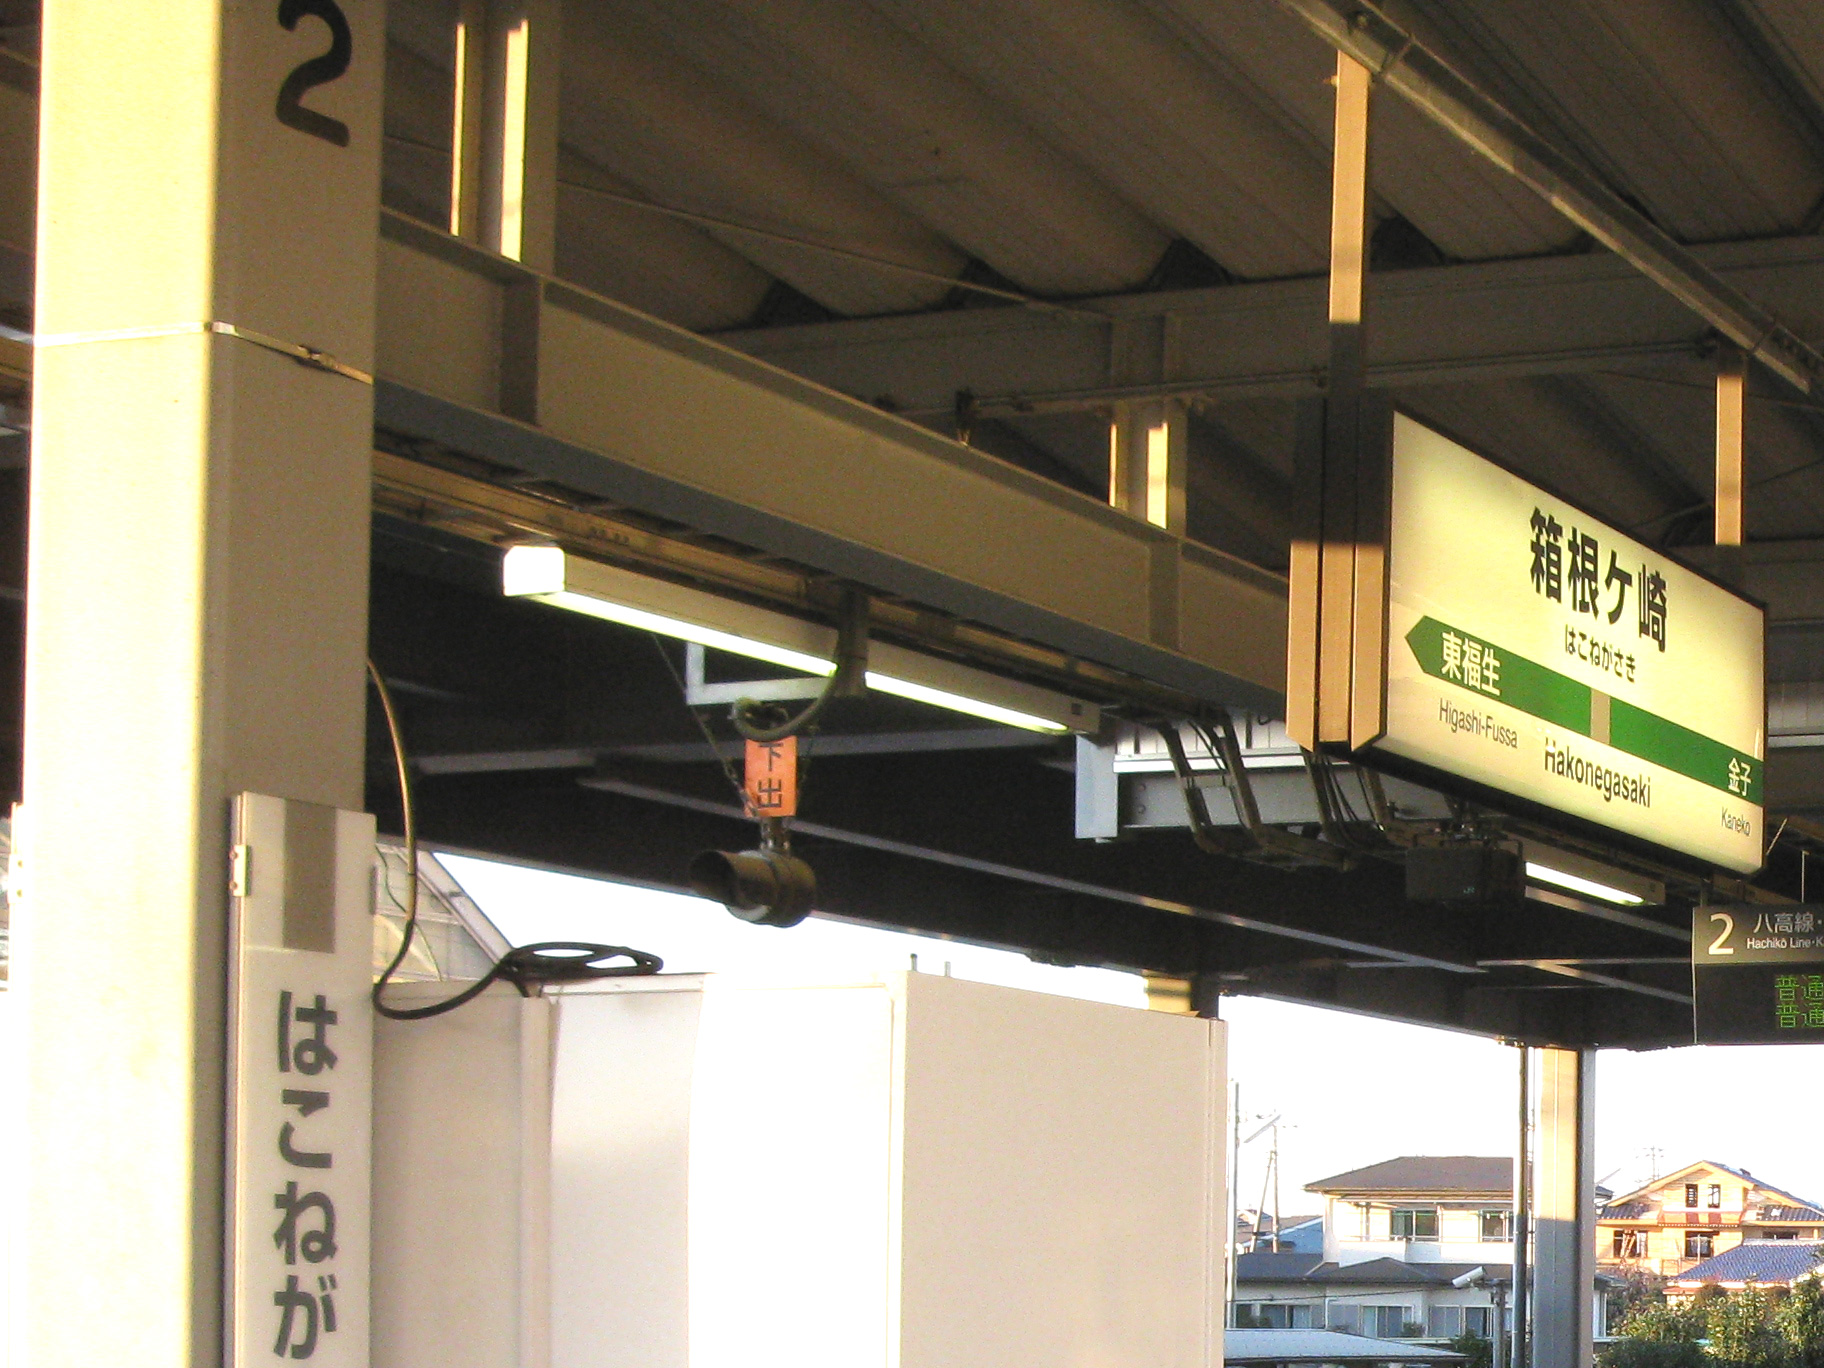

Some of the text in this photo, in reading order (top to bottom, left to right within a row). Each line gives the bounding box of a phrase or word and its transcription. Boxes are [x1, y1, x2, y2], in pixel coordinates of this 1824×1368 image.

[275, 0, 353, 147] 2
[1441, 631, 1500, 696] 東福生
[1565, 625, 1636, 683] はこねがさき
[1439, 698, 1518, 750] Higashi-Fussa
[1544, 737, 1651, 808] Hakonegasaki
[1727, 757, 1752, 797] 金子
[1721, 806, 1751, 837] Kaneko
[1708, 912, 1735, 956] 2
